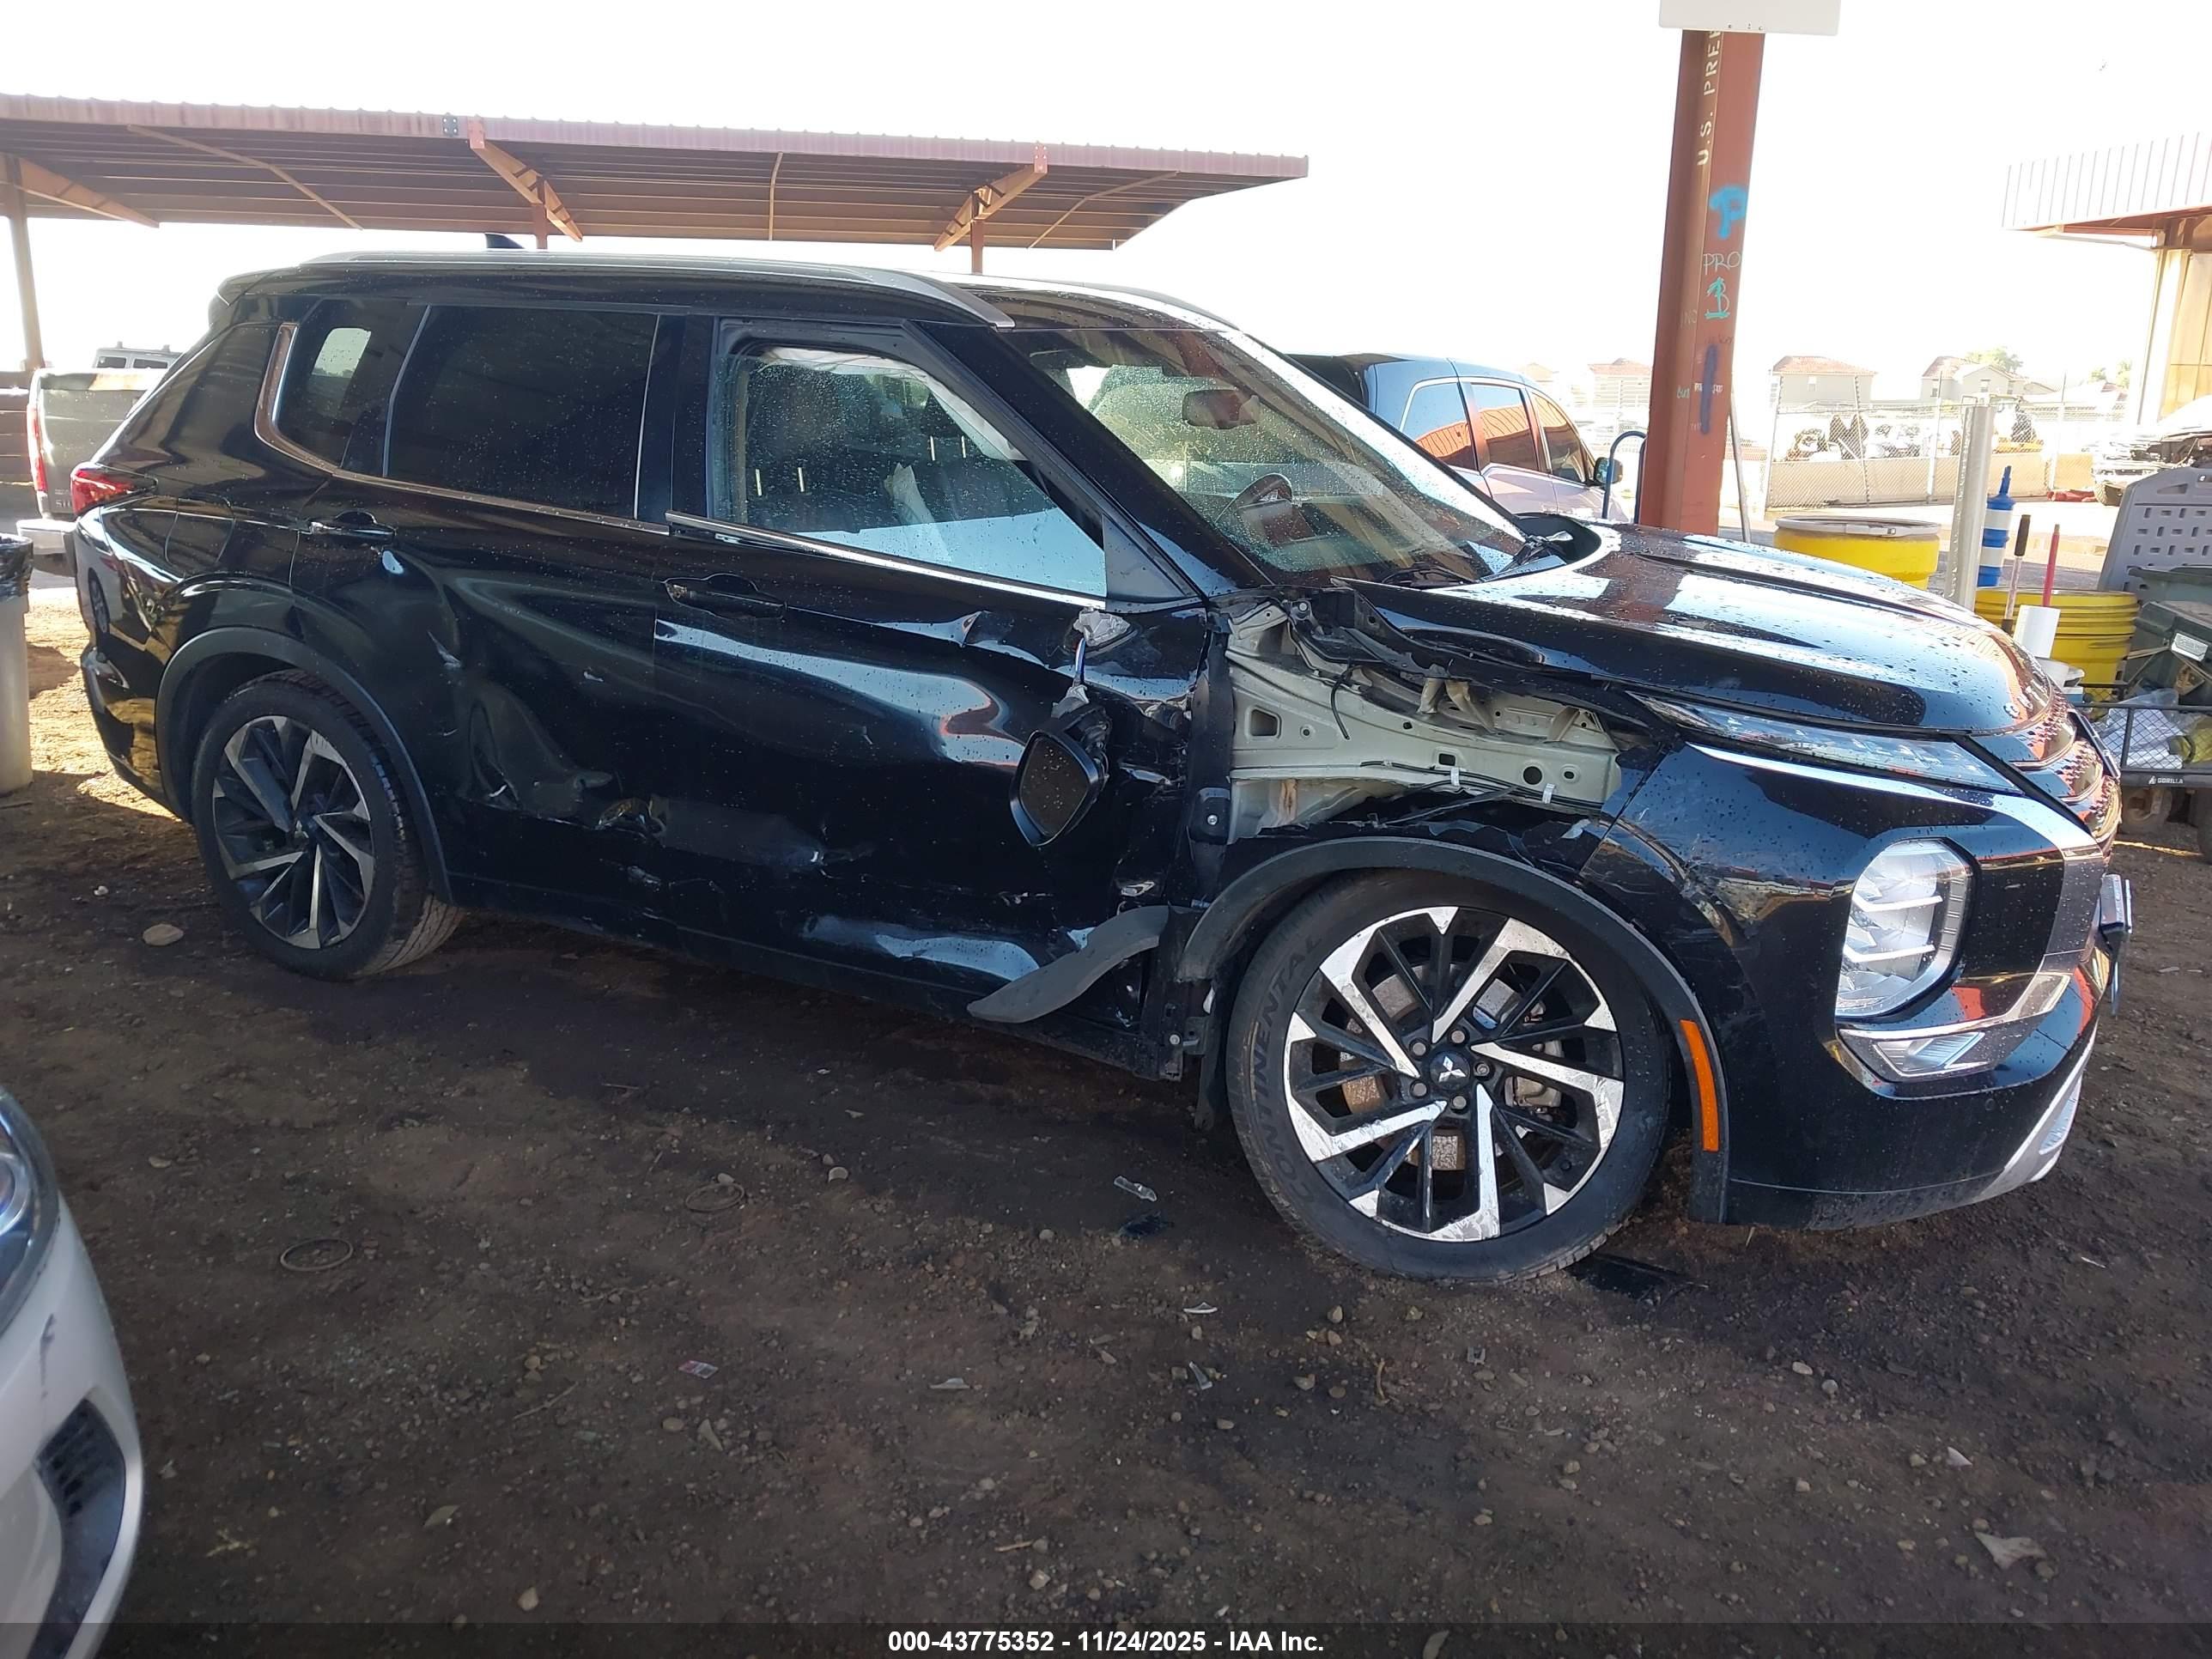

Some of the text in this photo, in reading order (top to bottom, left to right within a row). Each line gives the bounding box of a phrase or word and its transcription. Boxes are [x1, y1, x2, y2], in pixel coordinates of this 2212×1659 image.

[1697, 111, 1713, 166] U.S.
[1704, 251, 1741, 276] PRO
[1251, 935, 1322, 1200] CONTINENTAL
